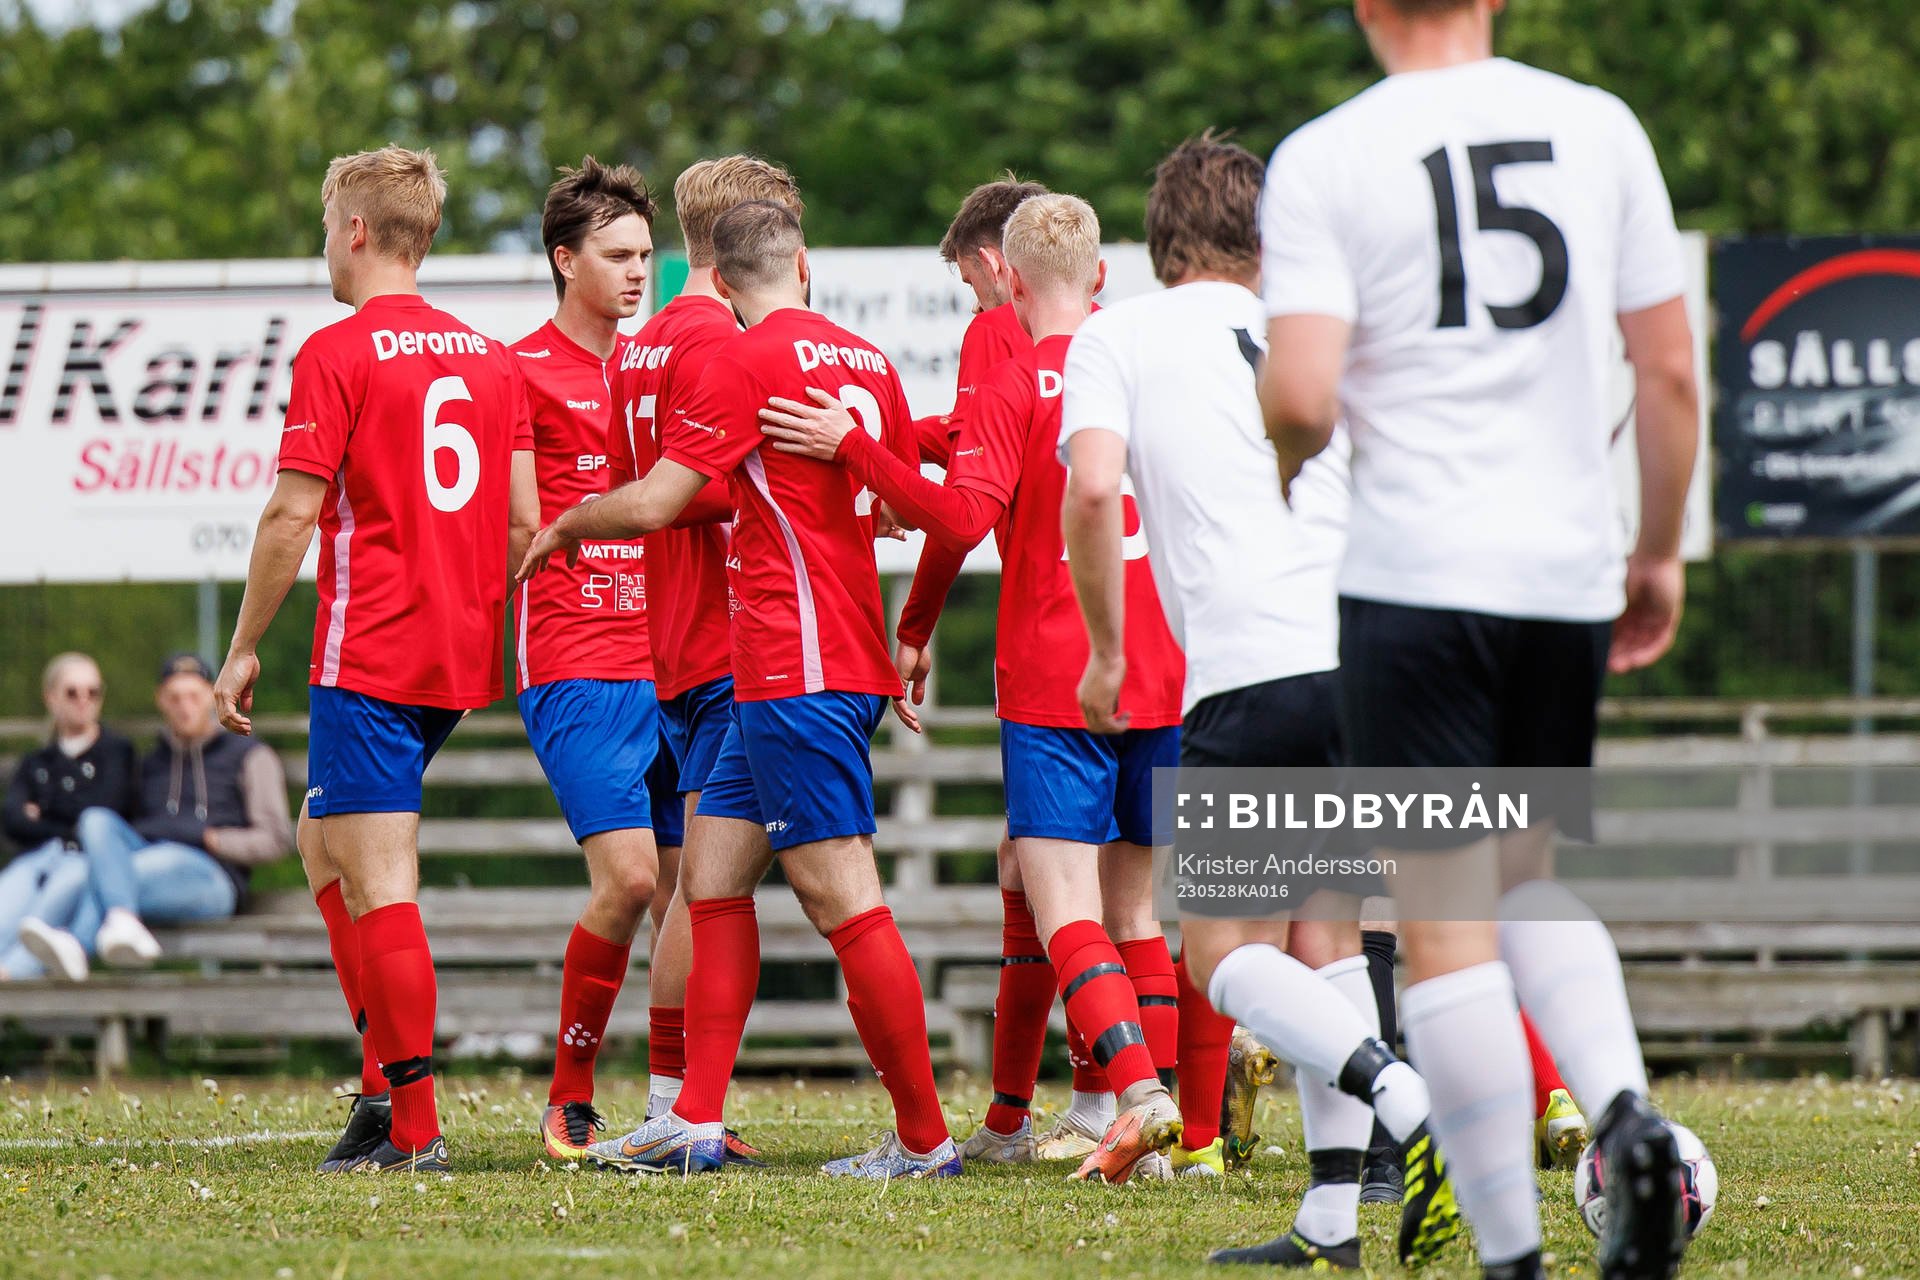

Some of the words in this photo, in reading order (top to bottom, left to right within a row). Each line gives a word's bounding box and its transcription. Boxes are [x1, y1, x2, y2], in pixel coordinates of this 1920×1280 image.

[1420, 140, 1569, 330] 15
[371, 329, 488, 361] Derome
[793, 339, 888, 376] Derome
[423, 375, 480, 512] 6
[577, 454, 610, 471] SP
